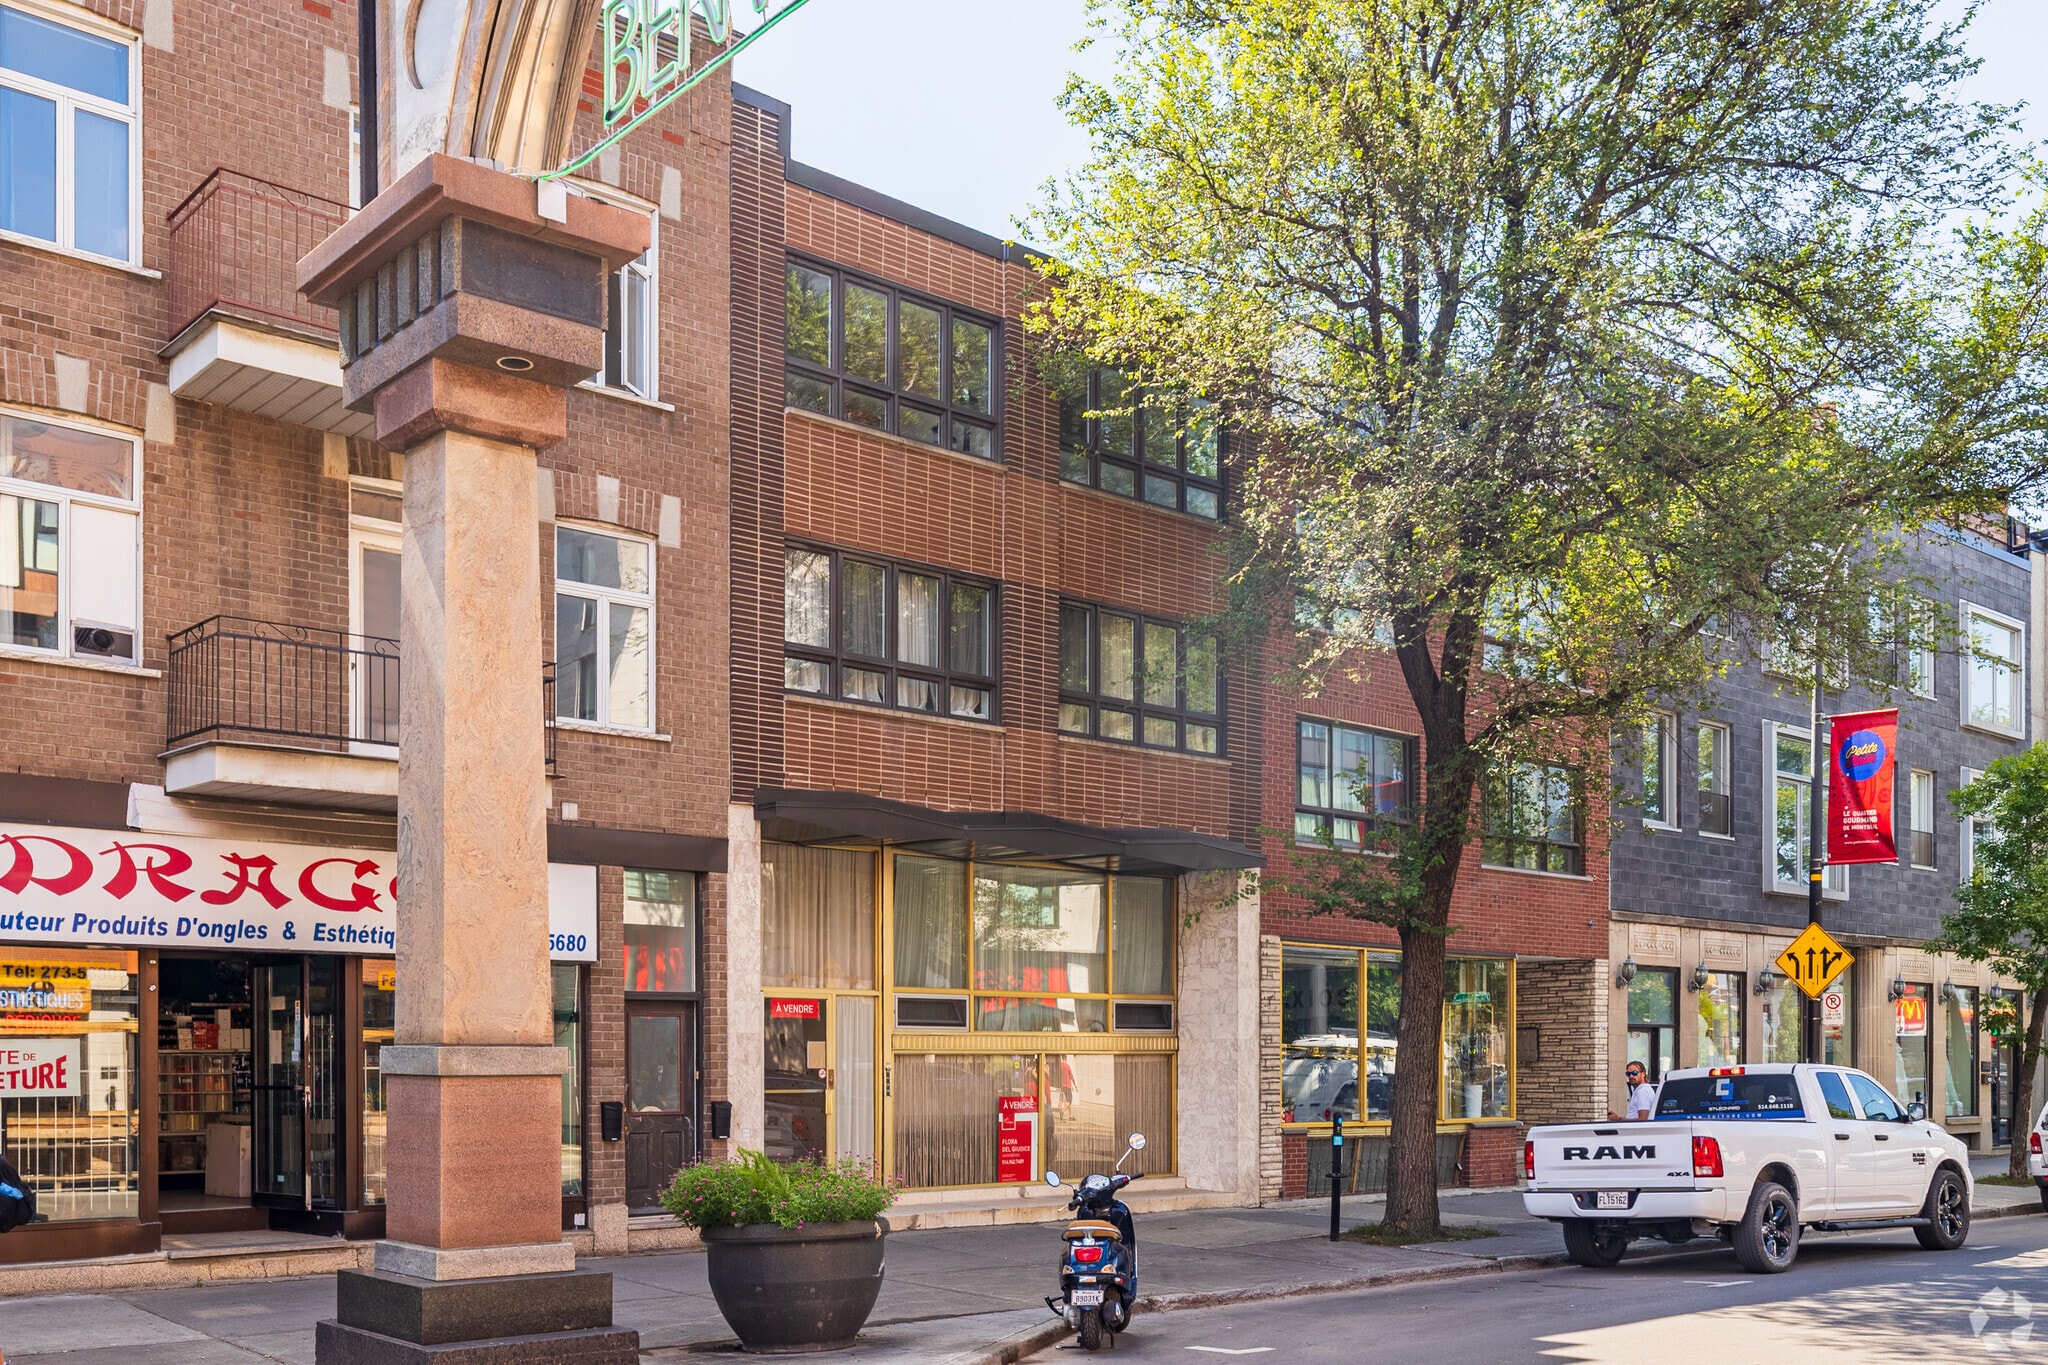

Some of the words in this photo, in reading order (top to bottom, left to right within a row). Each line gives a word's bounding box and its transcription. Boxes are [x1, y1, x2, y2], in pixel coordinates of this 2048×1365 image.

[0, 834, 397, 912] DRAG
[72, 913, 168, 936] Produits
[176, 917, 268, 943] D'ongles
[282, 921, 296, 940] &
[313, 923, 395, 949] Esthétiq
[3, 964, 35, 979] Tél:
[776, 1002, 782, 1013] À
[783, 1003, 814, 1014] VENDRE
[23, 1053, 36, 1062] DE
[1003, 1099, 1009, 1110] À
[1009, 1100, 1034, 1110] VENDRE
[1563, 1145, 1656, 1161] RAM
